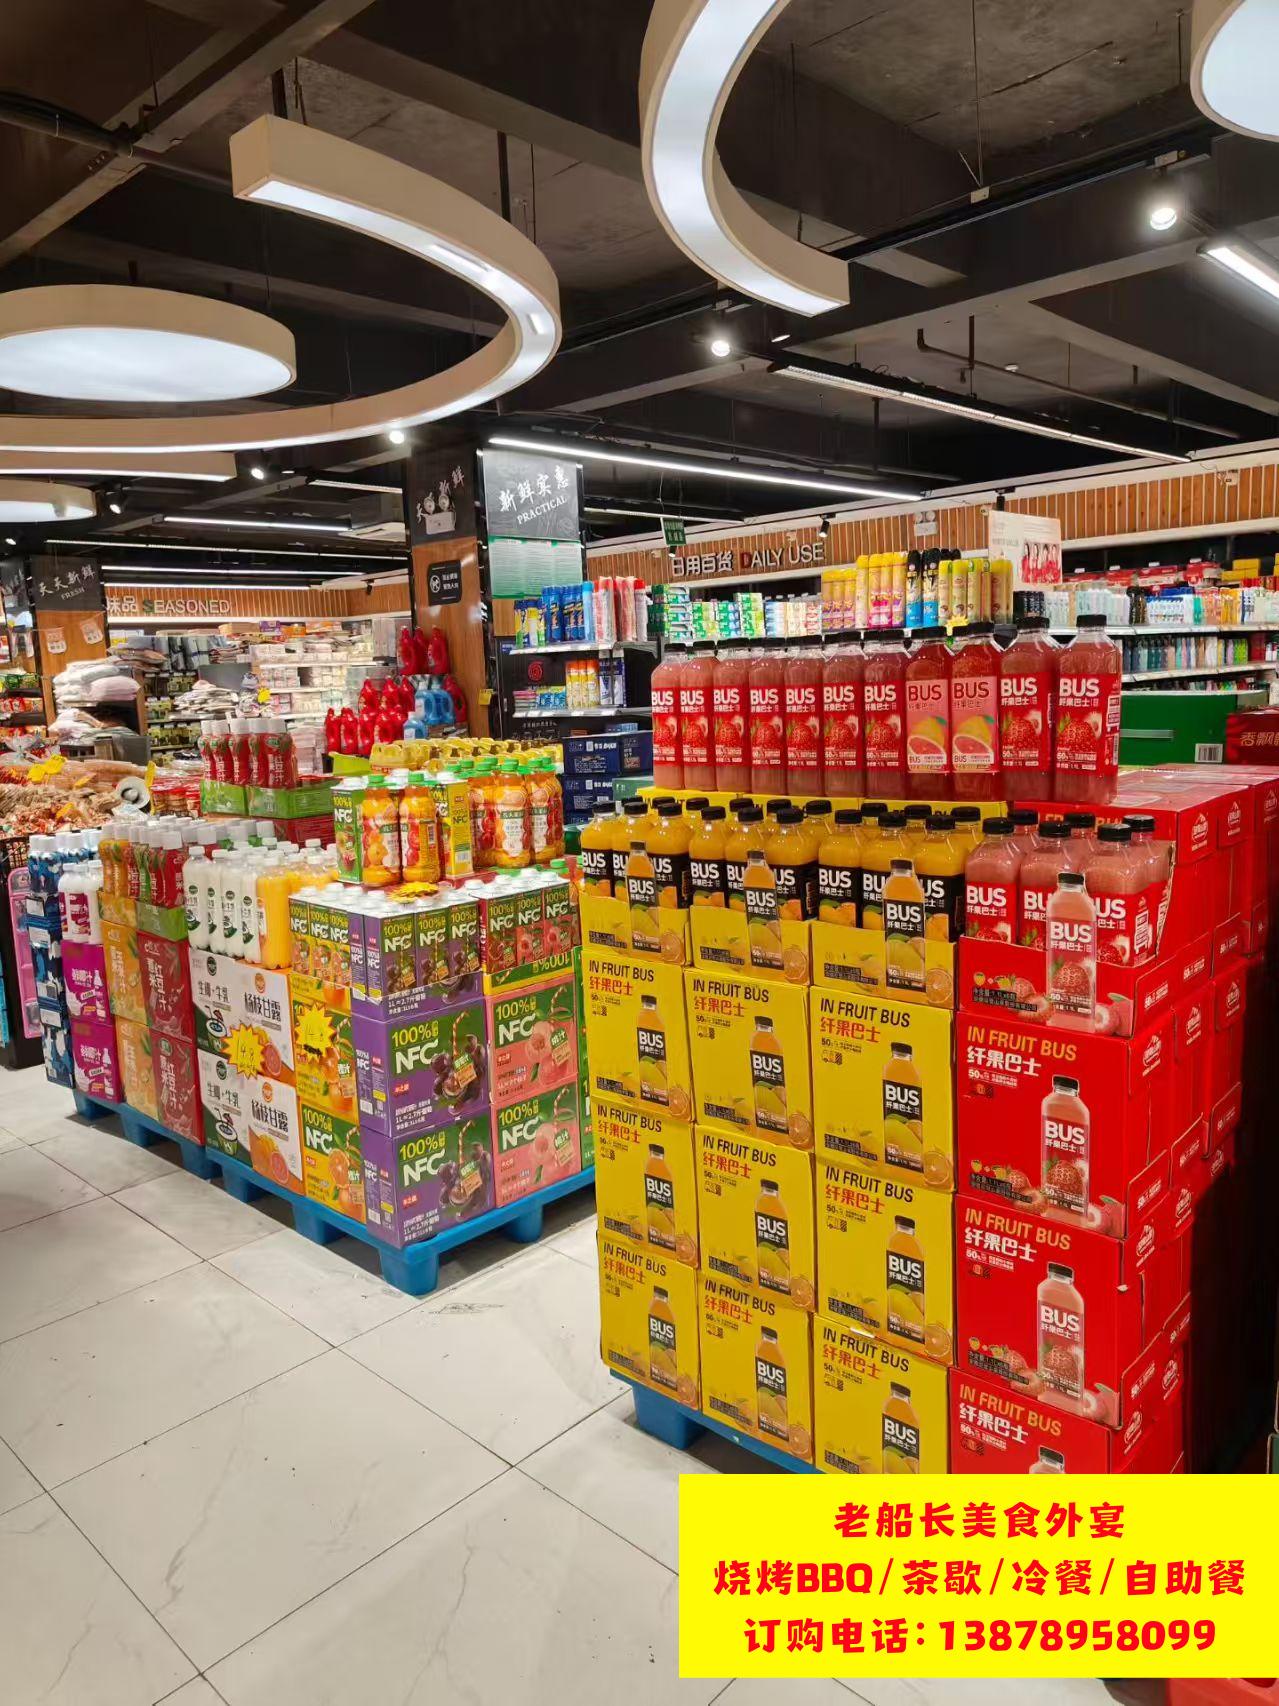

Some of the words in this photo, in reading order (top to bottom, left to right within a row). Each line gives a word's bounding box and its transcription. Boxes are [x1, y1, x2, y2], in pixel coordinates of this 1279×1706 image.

[498, 465, 569, 512] 新鲜实惠
[516, 495, 567, 524] PRACTICAL
[671, 550, 734, 577] 日用百货
[741, 548, 784, 569] DAILY
[788, 542, 824, 564] USE
[39, 564, 95, 597] 天天新鲜
[61, 586, 85, 600] FRESH
[143, 599, 230, 614] SEASONED
[680, 690, 704, 705] BUS
[714, 688, 740, 704] BUS
[750, 689, 779, 705] BUS
[786, 688, 815, 704] BUS
[824, 685, 855, 702] BUS
[864, 685, 896, 702] BUS
[908, 683, 942, 701] BUS
[954, 682, 990, 699] BUS
[1001, 677, 1037, 697] BUS
[1059, 677, 1099, 697] BUS
[652, 691, 673, 705] BUS
[334, 808, 352, 822] NFC
[453, 815, 467, 824] NFC
[582, 852, 606, 867] BUS
[613, 854, 629, 869] BU
[654, 858, 672, 873] US
[690, 862, 719, 879] BUS
[727, 864, 744, 881] BU
[776, 869, 795, 886] US
[819, 868, 852, 888] BUS
[629, 879, 654, 895] BUS
[863, 874, 885, 892] BU
[924, 880, 945, 898] US
[746, 890, 776, 907] BUS
[966, 885, 1006, 907] BUS
[1024, 890, 1049, 911] BU
[518, 908, 540, 926] NFC
[546, 902, 568, 919] NFC
[887, 904, 922, 922] BUS
[966, 905, 998, 916] 纤果巴士
[1095, 897, 1126, 919] US
[291, 918, 307, 933] NFC
[311, 923, 329, 938] NFC
[452, 921, 476, 939] NFC
[490, 915, 514, 932] NFC
[1050, 921, 1092, 943] BUS
[330, 927, 349, 943] NFC
[385, 934, 412, 953] NFC
[419, 928, 446, 947] NFC
[589, 960, 600, 973] IN
[602, 963, 631, 979] FRUIT
[633, 967, 654, 982] BUS
[589, 976, 633, 996] 纤果巴士
[693, 979, 705, 993] IN
[708, 981, 741, 999] FRUIT
[744, 985, 769, 1003] BUS
[693, 997, 745, 1018] 纤果巴士
[820, 998, 834, 1013] IN
[837, 1001, 878, 1022] FRUIT
[880, 1009, 911, 1028] BUS
[499, 1012, 536, 1045] NFC
[639, 1030, 664, 1048] BUS
[820, 1016, 881, 1043] 纤果巴士
[967, 1026, 984, 1043] IN
[989, 1030, 1038, 1054] FRUIT
[1040, 1039, 1077, 1061] BUS
[396, 1039, 439, 1074] NFC
[752, 1053, 781, 1074] BUS
[966, 1045, 1041, 1077] 纤果巴士
[885, 1084, 920, 1107] BUS
[597, 1104, 608, 1118] IN
[609, 1107, 638, 1125] FRUIT
[640, 1115, 662, 1132] BUS
[305, 1126, 333, 1154] NFC
[502, 1116, 539, 1151] NFC
[597, 1119, 641, 1144] 纤果巴士
[1045, 1121, 1085, 1145] BUS
[703, 1135, 715, 1149] IN
[717, 1139, 749, 1159] FRUIT
[752, 1149, 777, 1167] BUS
[403, 1148, 446, 1187] NFC
[703, 1152, 752, 1179] 纤果巴士
[646, 1177, 671, 1196] BUS
[826, 1165, 840, 1180] IN
[843, 1171, 882, 1194] FRUIT
[884, 1182, 914, 1203] BUS
[825, 1183, 886, 1215] 纤果巴士
[757, 1215, 786, 1237] BUS
[965, 1208, 982, 1227] IN
[986, 1212, 1032, 1239] FRUIT
[1036, 1227, 1071, 1251] BUS
[964, 1227, 1037, 1263] 纤果巴士
[604, 1242, 613, 1255] IN
[616, 1245, 643, 1264] FRUIT
[645, 1258, 667, 1276] BUS
[888, 1254, 922, 1279] BUS
[603, 1257, 646, 1284] 纤果巴士
[705, 1279, 716, 1293] IN
[719, 1284, 750, 1304] FRUIT
[752, 1296, 776, 1316] BUS
[705, 1295, 752, 1325] 纤果巴士
[1040, 1304, 1080, 1333] BUS
[650, 1318, 674, 1339] BUS
[823, 1327, 837, 1343] IN
[840, 1334, 878, 1359] FRUIT
[880, 1350, 910, 1372] BUS
[823, 1343, 882, 1380] 纤果巴士
[758, 1361, 785, 1384] BUS
[959, 1383, 975, 1402] IN
[979, 1390, 1025, 1422] FRUIT
[1028, 1410, 1062, 1437] BUS
[884, 1417, 917, 1444] BUS
[959, 1402, 1029, 1444] 纤果巴士
